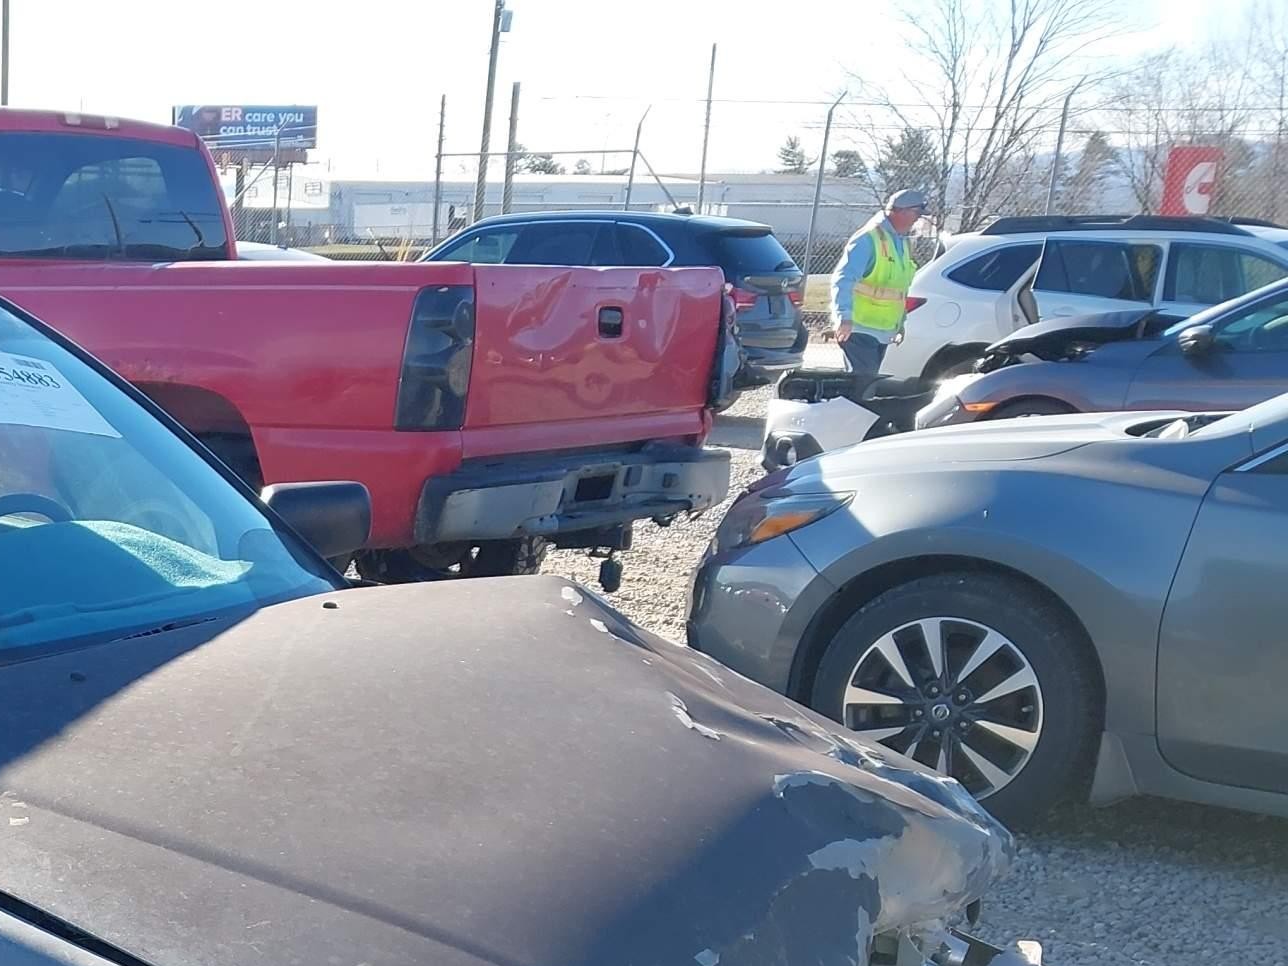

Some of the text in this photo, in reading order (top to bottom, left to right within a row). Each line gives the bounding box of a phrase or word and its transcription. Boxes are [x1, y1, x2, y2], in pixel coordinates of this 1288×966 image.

[221, 107, 304, 125] ER care you
[219, 124, 278, 136] can trust
